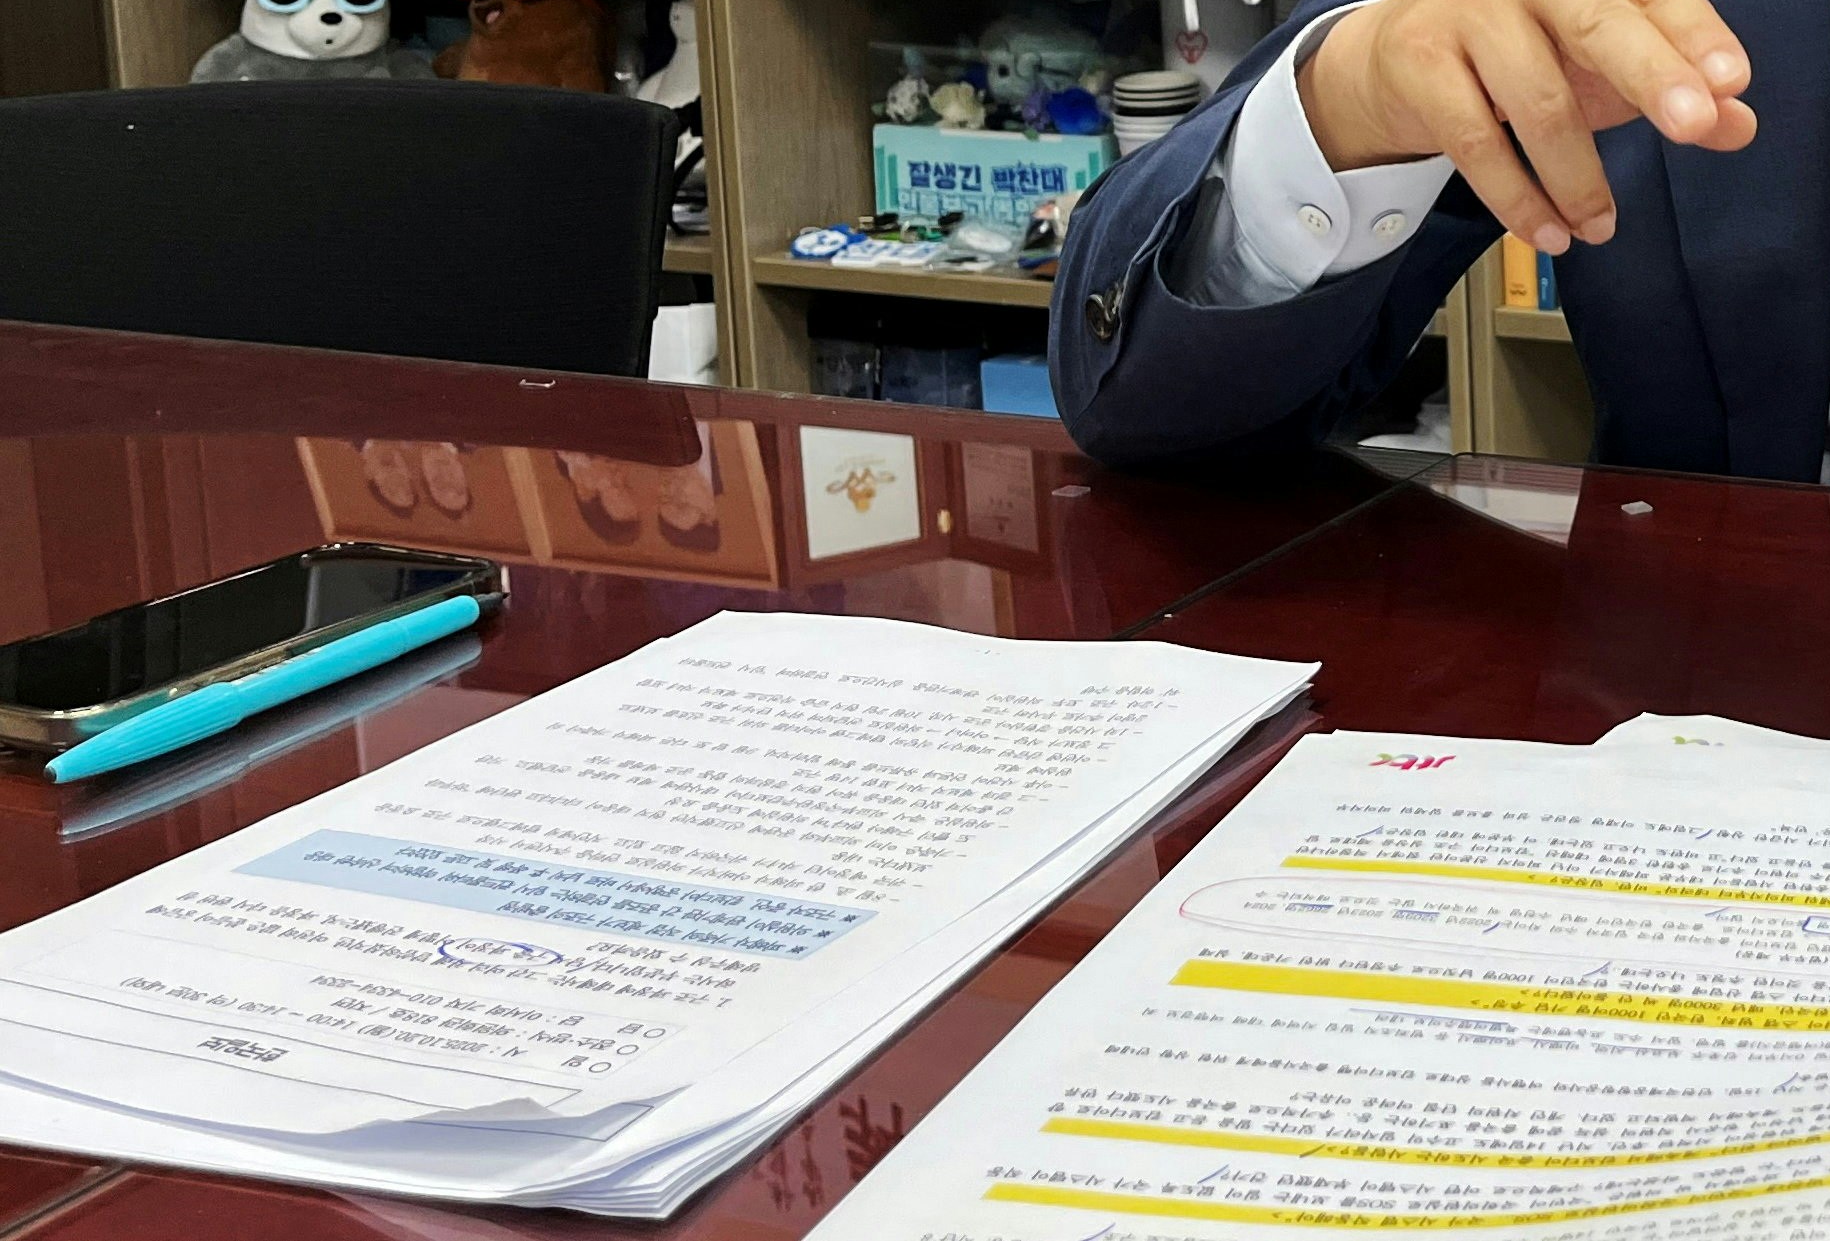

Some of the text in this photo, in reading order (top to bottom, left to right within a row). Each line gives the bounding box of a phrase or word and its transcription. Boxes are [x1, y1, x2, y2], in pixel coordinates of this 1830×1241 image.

[907, 160, 1069, 194] 잘생긴 박찬대
[196, 1035, 289, 1063] 한국일보
